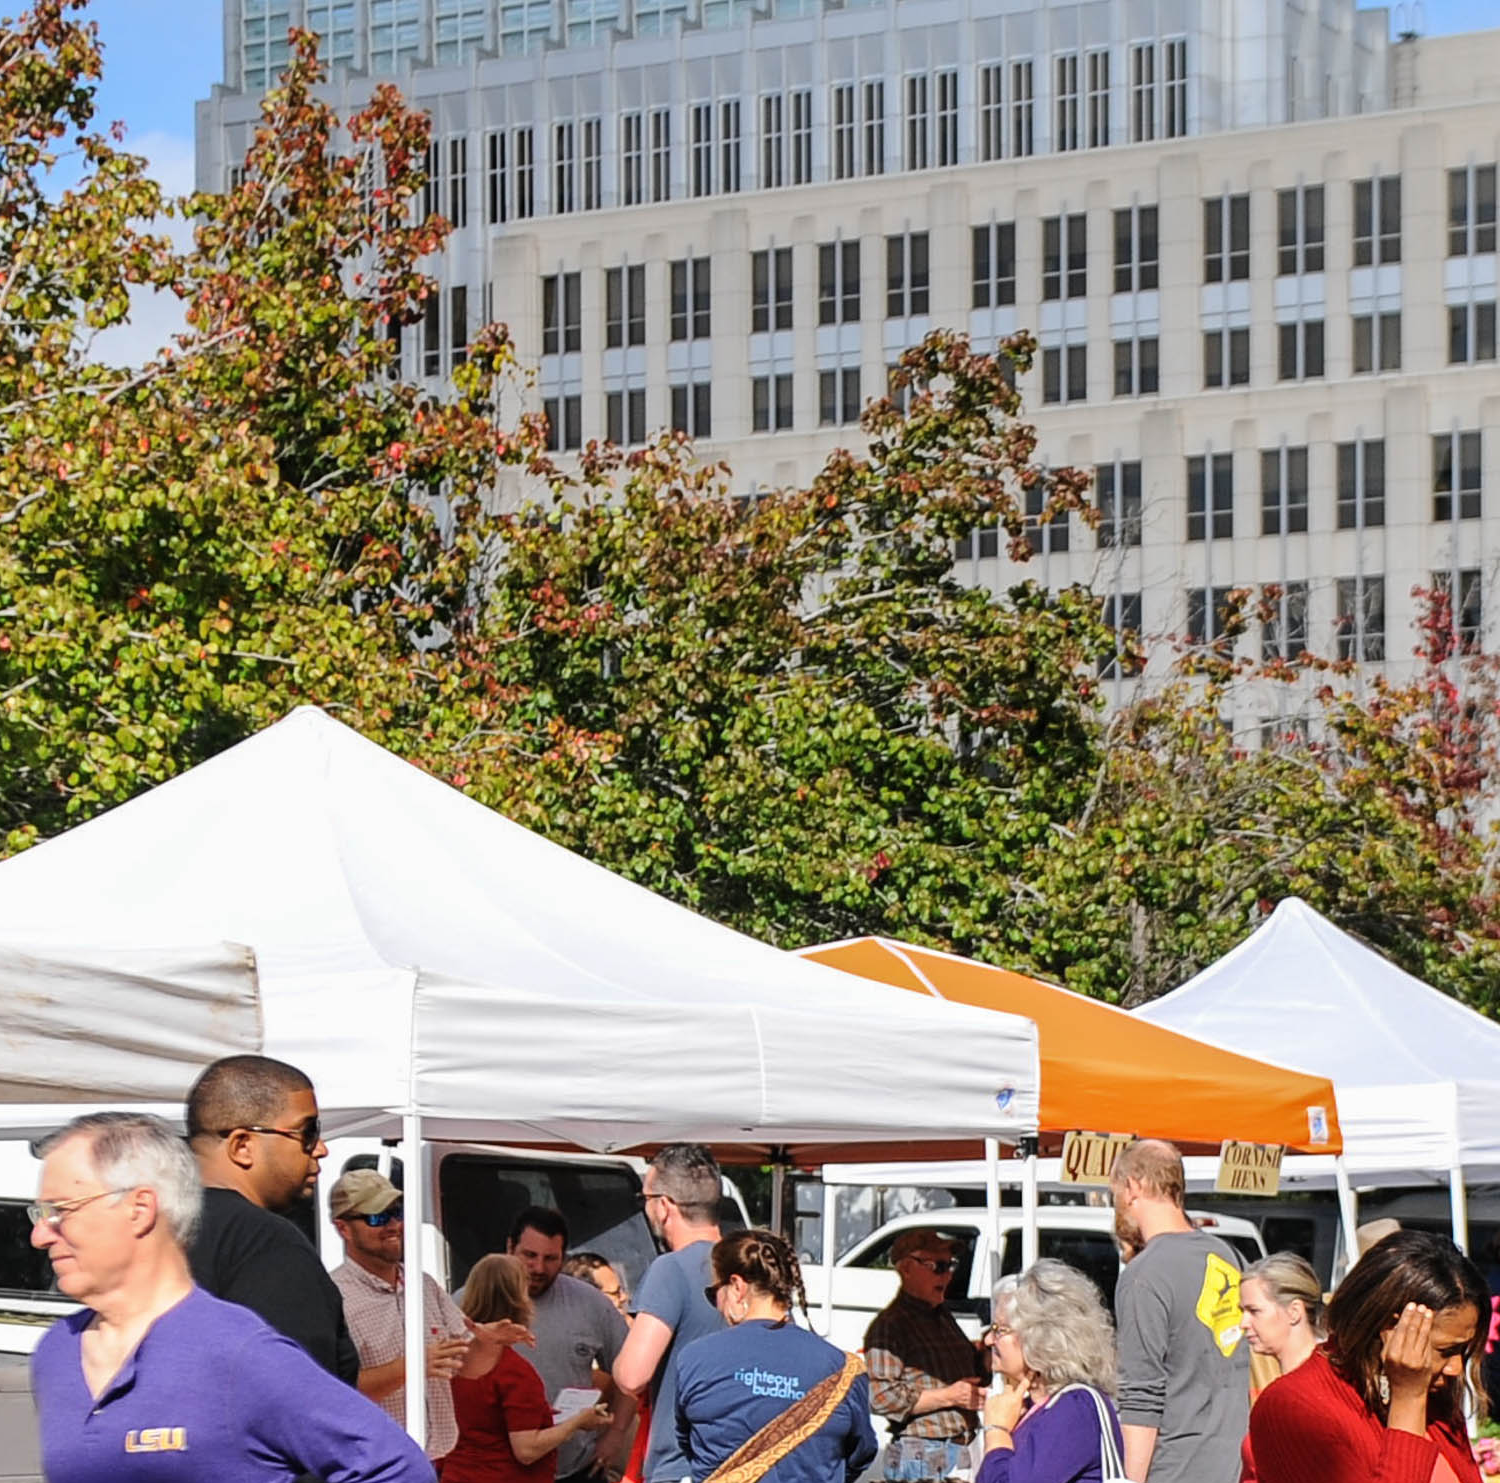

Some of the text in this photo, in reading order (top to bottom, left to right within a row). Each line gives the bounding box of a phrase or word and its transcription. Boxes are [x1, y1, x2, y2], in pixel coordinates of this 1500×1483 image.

[1066, 1138, 1128, 1182] QUAI
[1224, 1145, 1282, 1168] CORNISH
[1230, 1169, 1267, 1189] HENS
[734, 1367, 799, 1387] righteous
[752, 1383, 805, 1400] buddha
[124, 1427, 189, 1453] LSU
